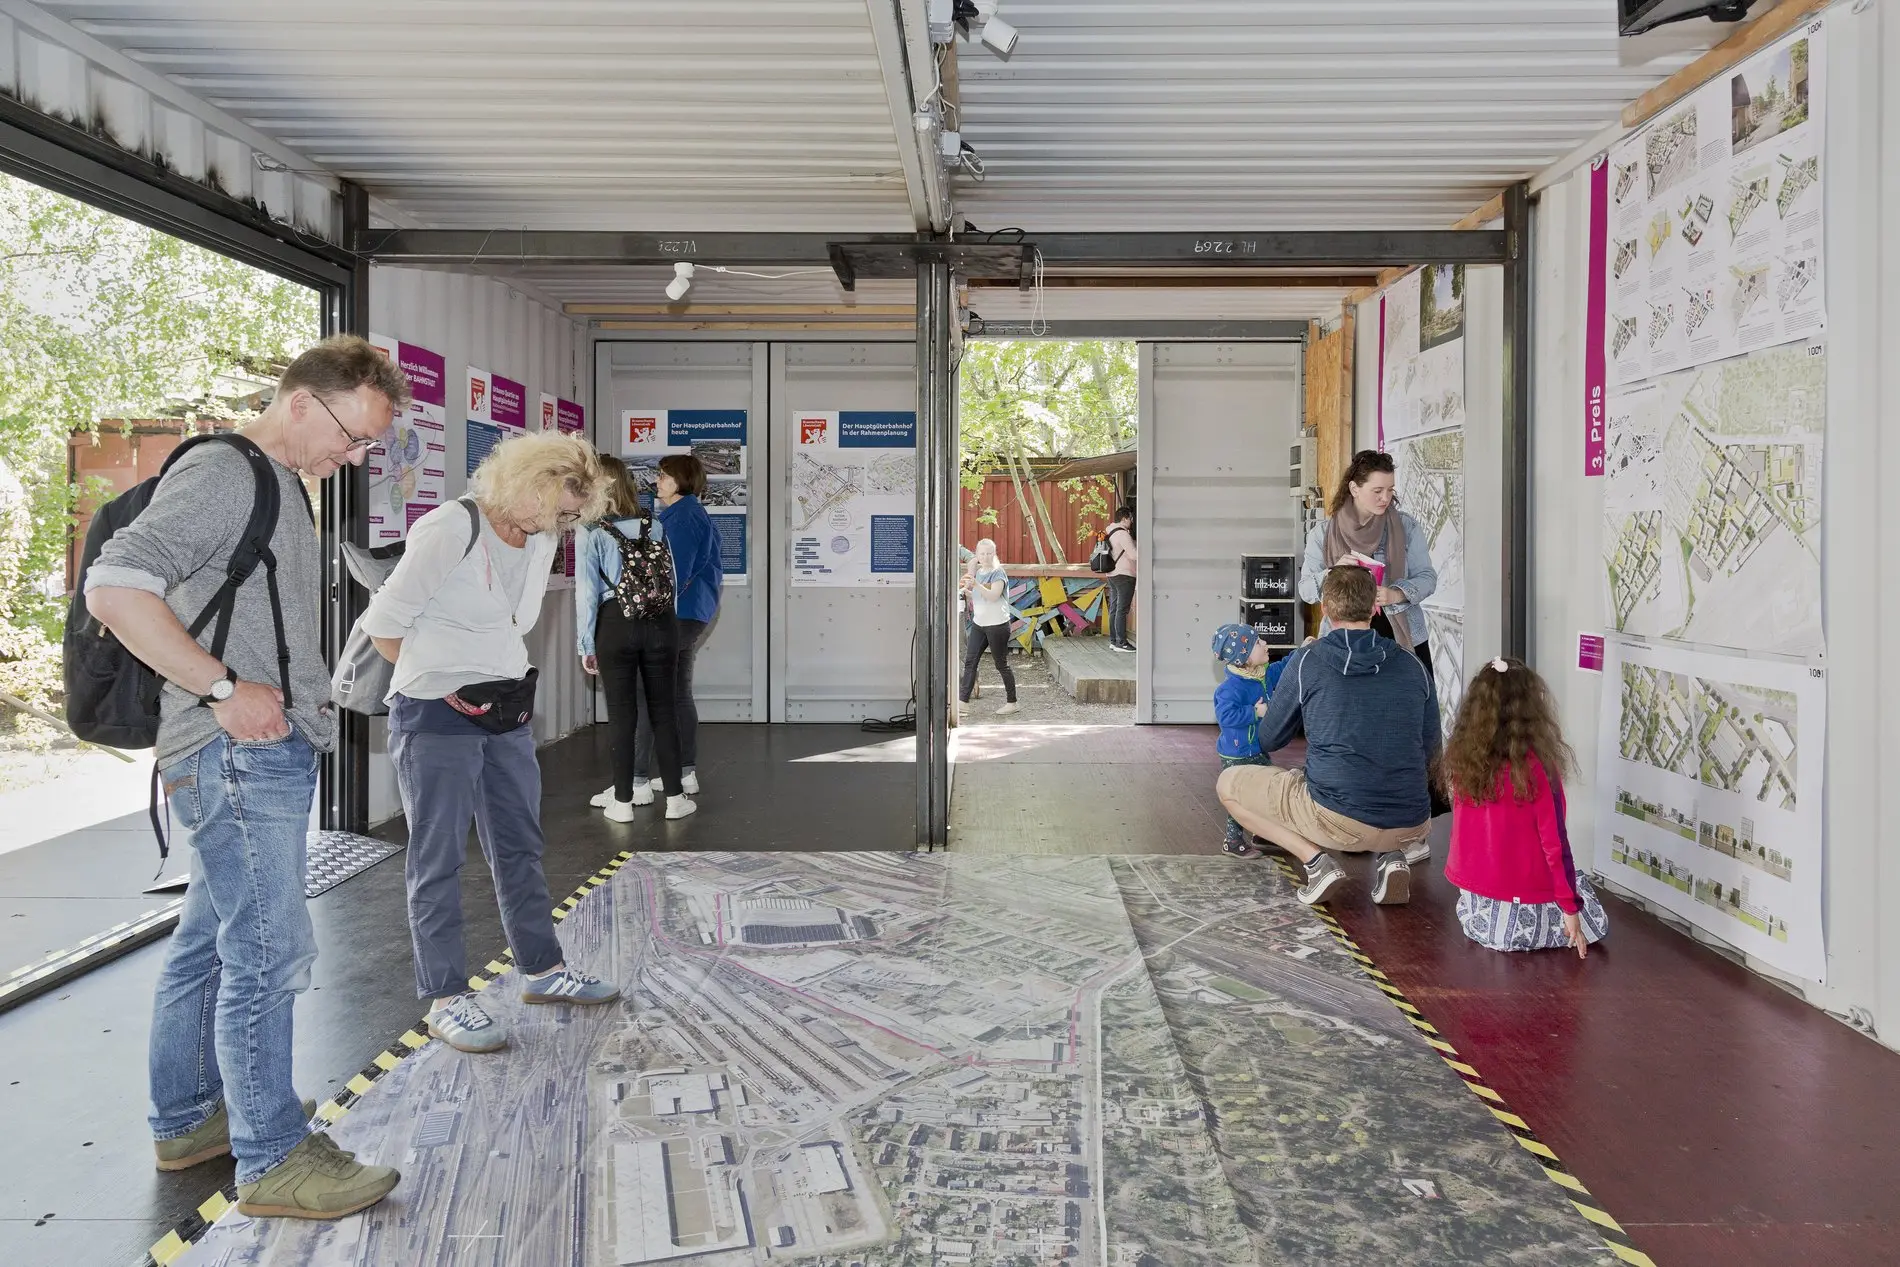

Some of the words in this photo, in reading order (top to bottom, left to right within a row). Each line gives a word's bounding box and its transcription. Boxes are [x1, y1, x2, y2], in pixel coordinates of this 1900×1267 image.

[400, 360, 419, 372] Herzlich
[1590, 385, 1602, 443] Preis
[683, 422, 742, 430] Hauptgüterbahnhof
[854, 422, 913, 430] Hauptgüterbahnhof
[860, 429, 908, 437] Rahmenplanung
[1591, 449, 1603, 468] 3.
[1254, 579, 1286, 589] fritz-kola
[1254, 622, 1286, 632] fritz-kola
